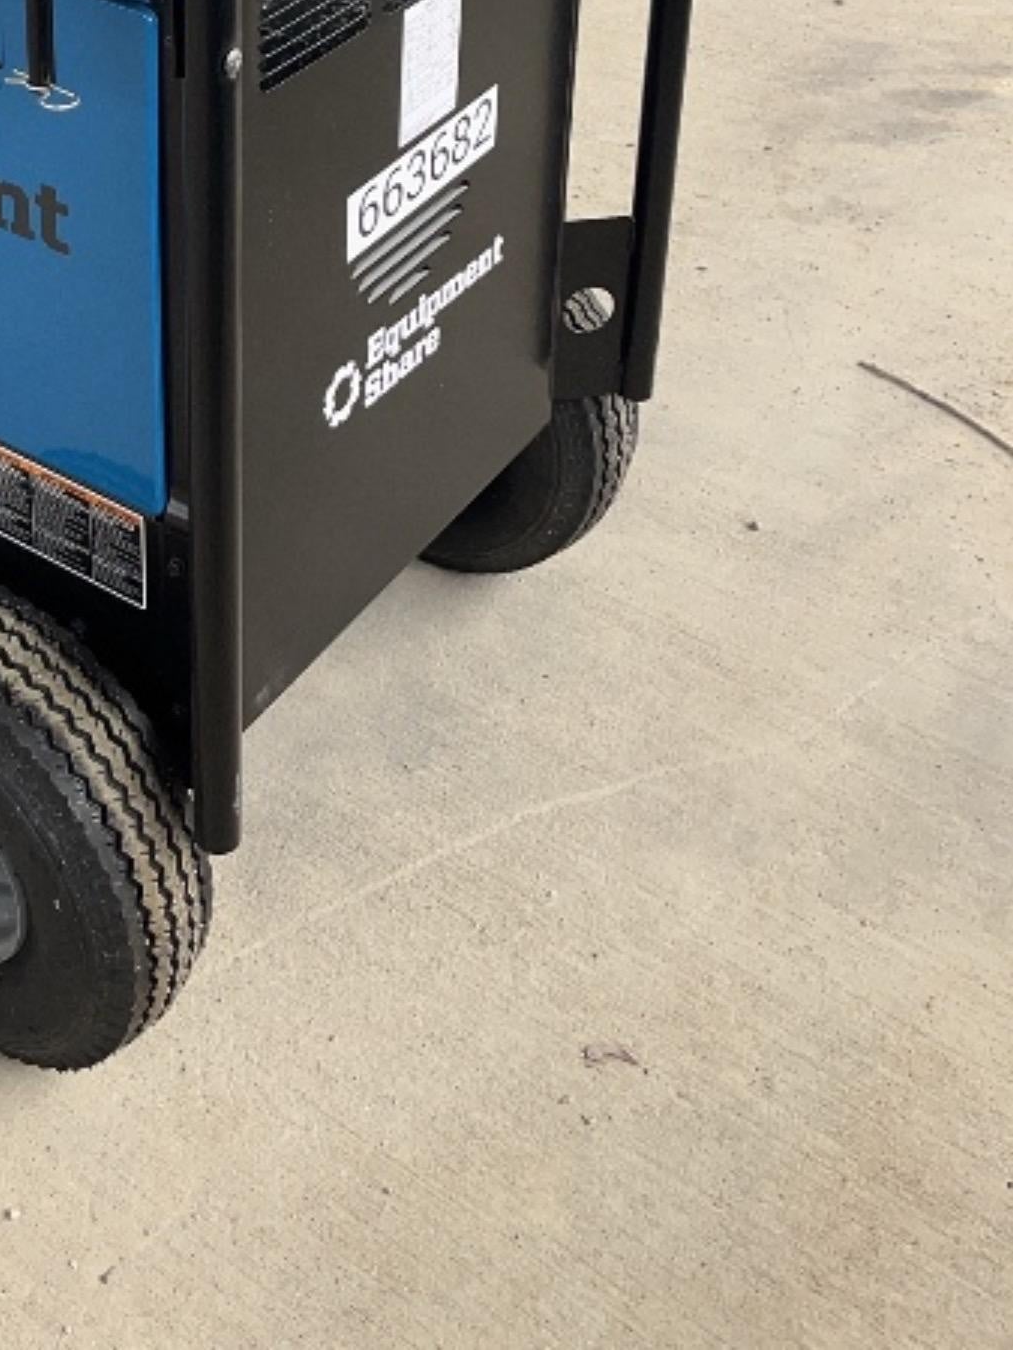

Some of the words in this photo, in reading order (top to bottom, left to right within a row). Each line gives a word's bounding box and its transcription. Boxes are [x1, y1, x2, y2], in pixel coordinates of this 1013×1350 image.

[358, 99, 493, 238] 663682
[364, 326, 442, 410] Share
[365, 234, 505, 370] Equipment
